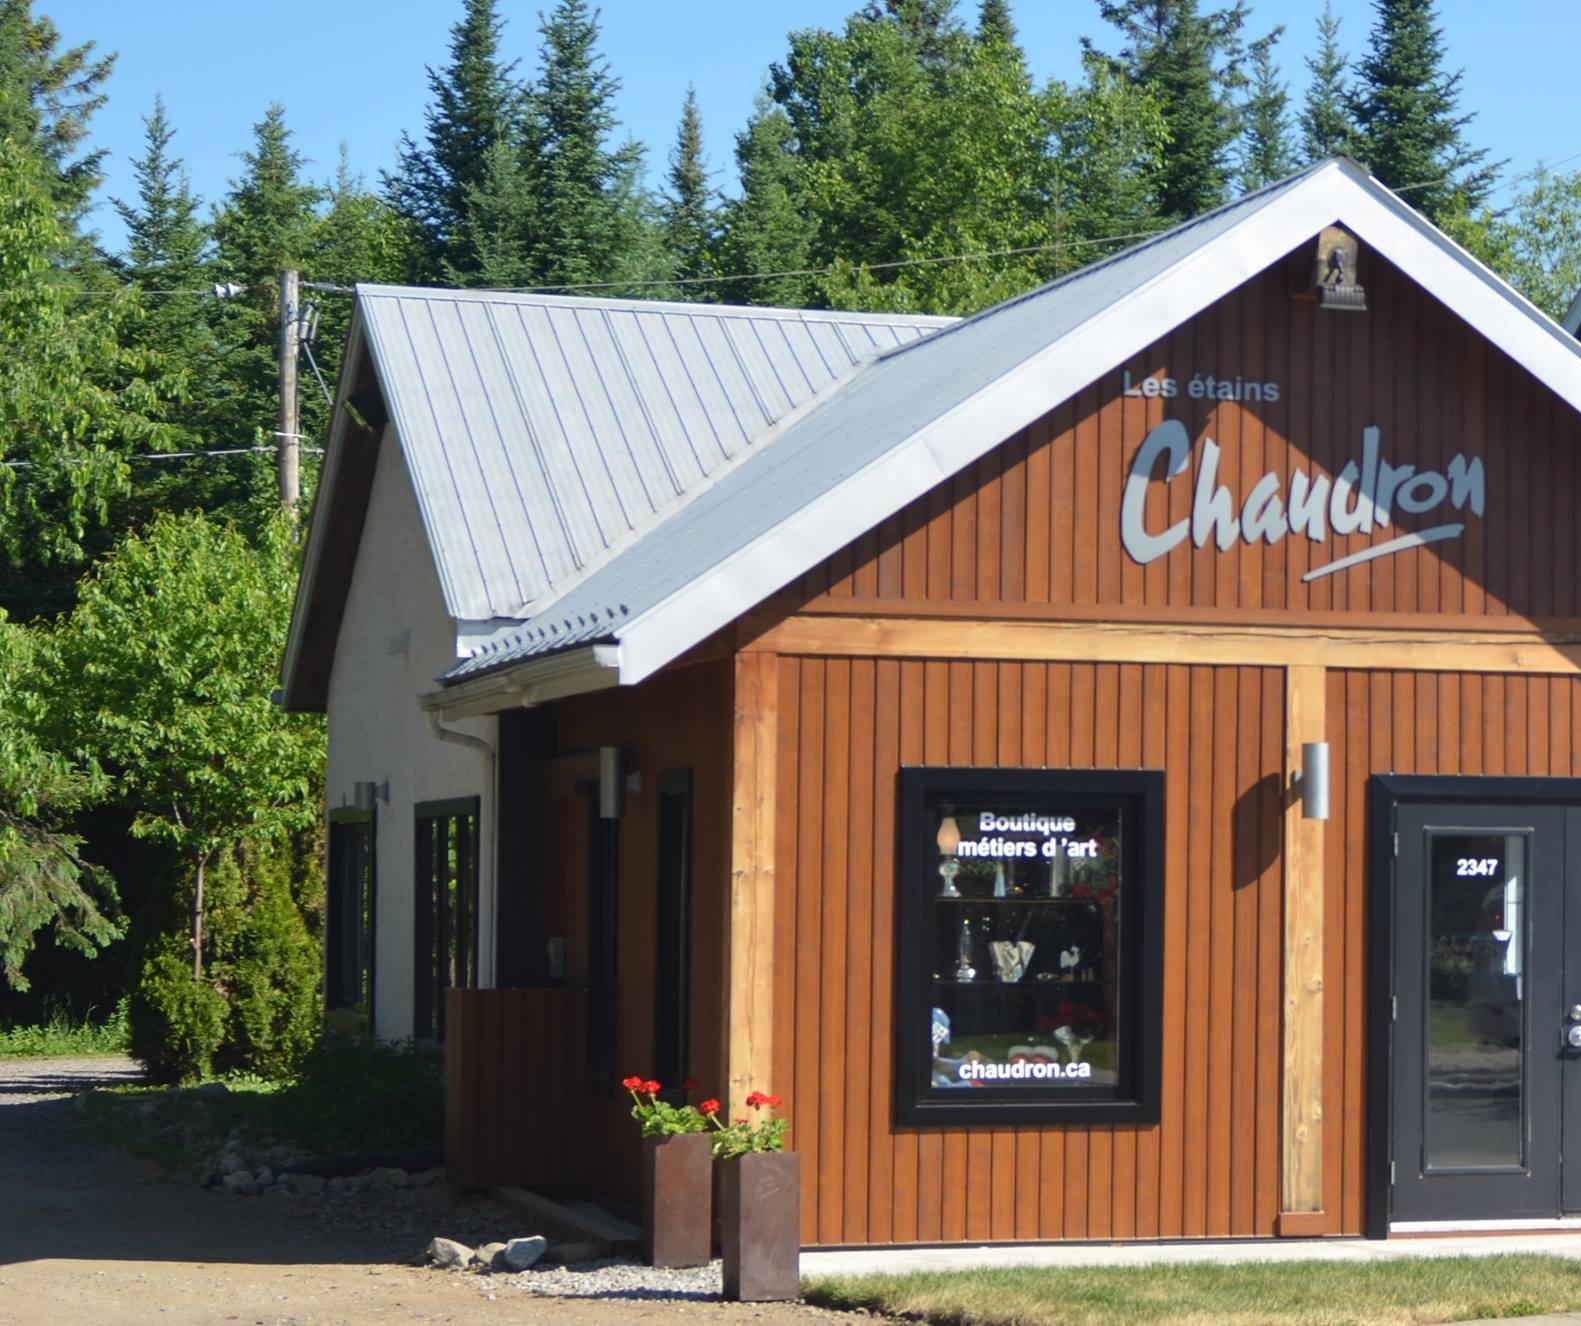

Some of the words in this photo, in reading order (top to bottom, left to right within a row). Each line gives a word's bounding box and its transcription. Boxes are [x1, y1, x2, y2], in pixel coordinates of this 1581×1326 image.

[1123, 370, 1177, 396] Les
[1188, 374, 1280, 401] étains
[1121, 419, 1485, 565] Chaudron
[979, 812, 1076, 834] Boutique
[957, 837, 1037, 857] métiers
[1457, 859, 1499, 876] 2347
[958, 1059, 1091, 1079] chaudron.ca
